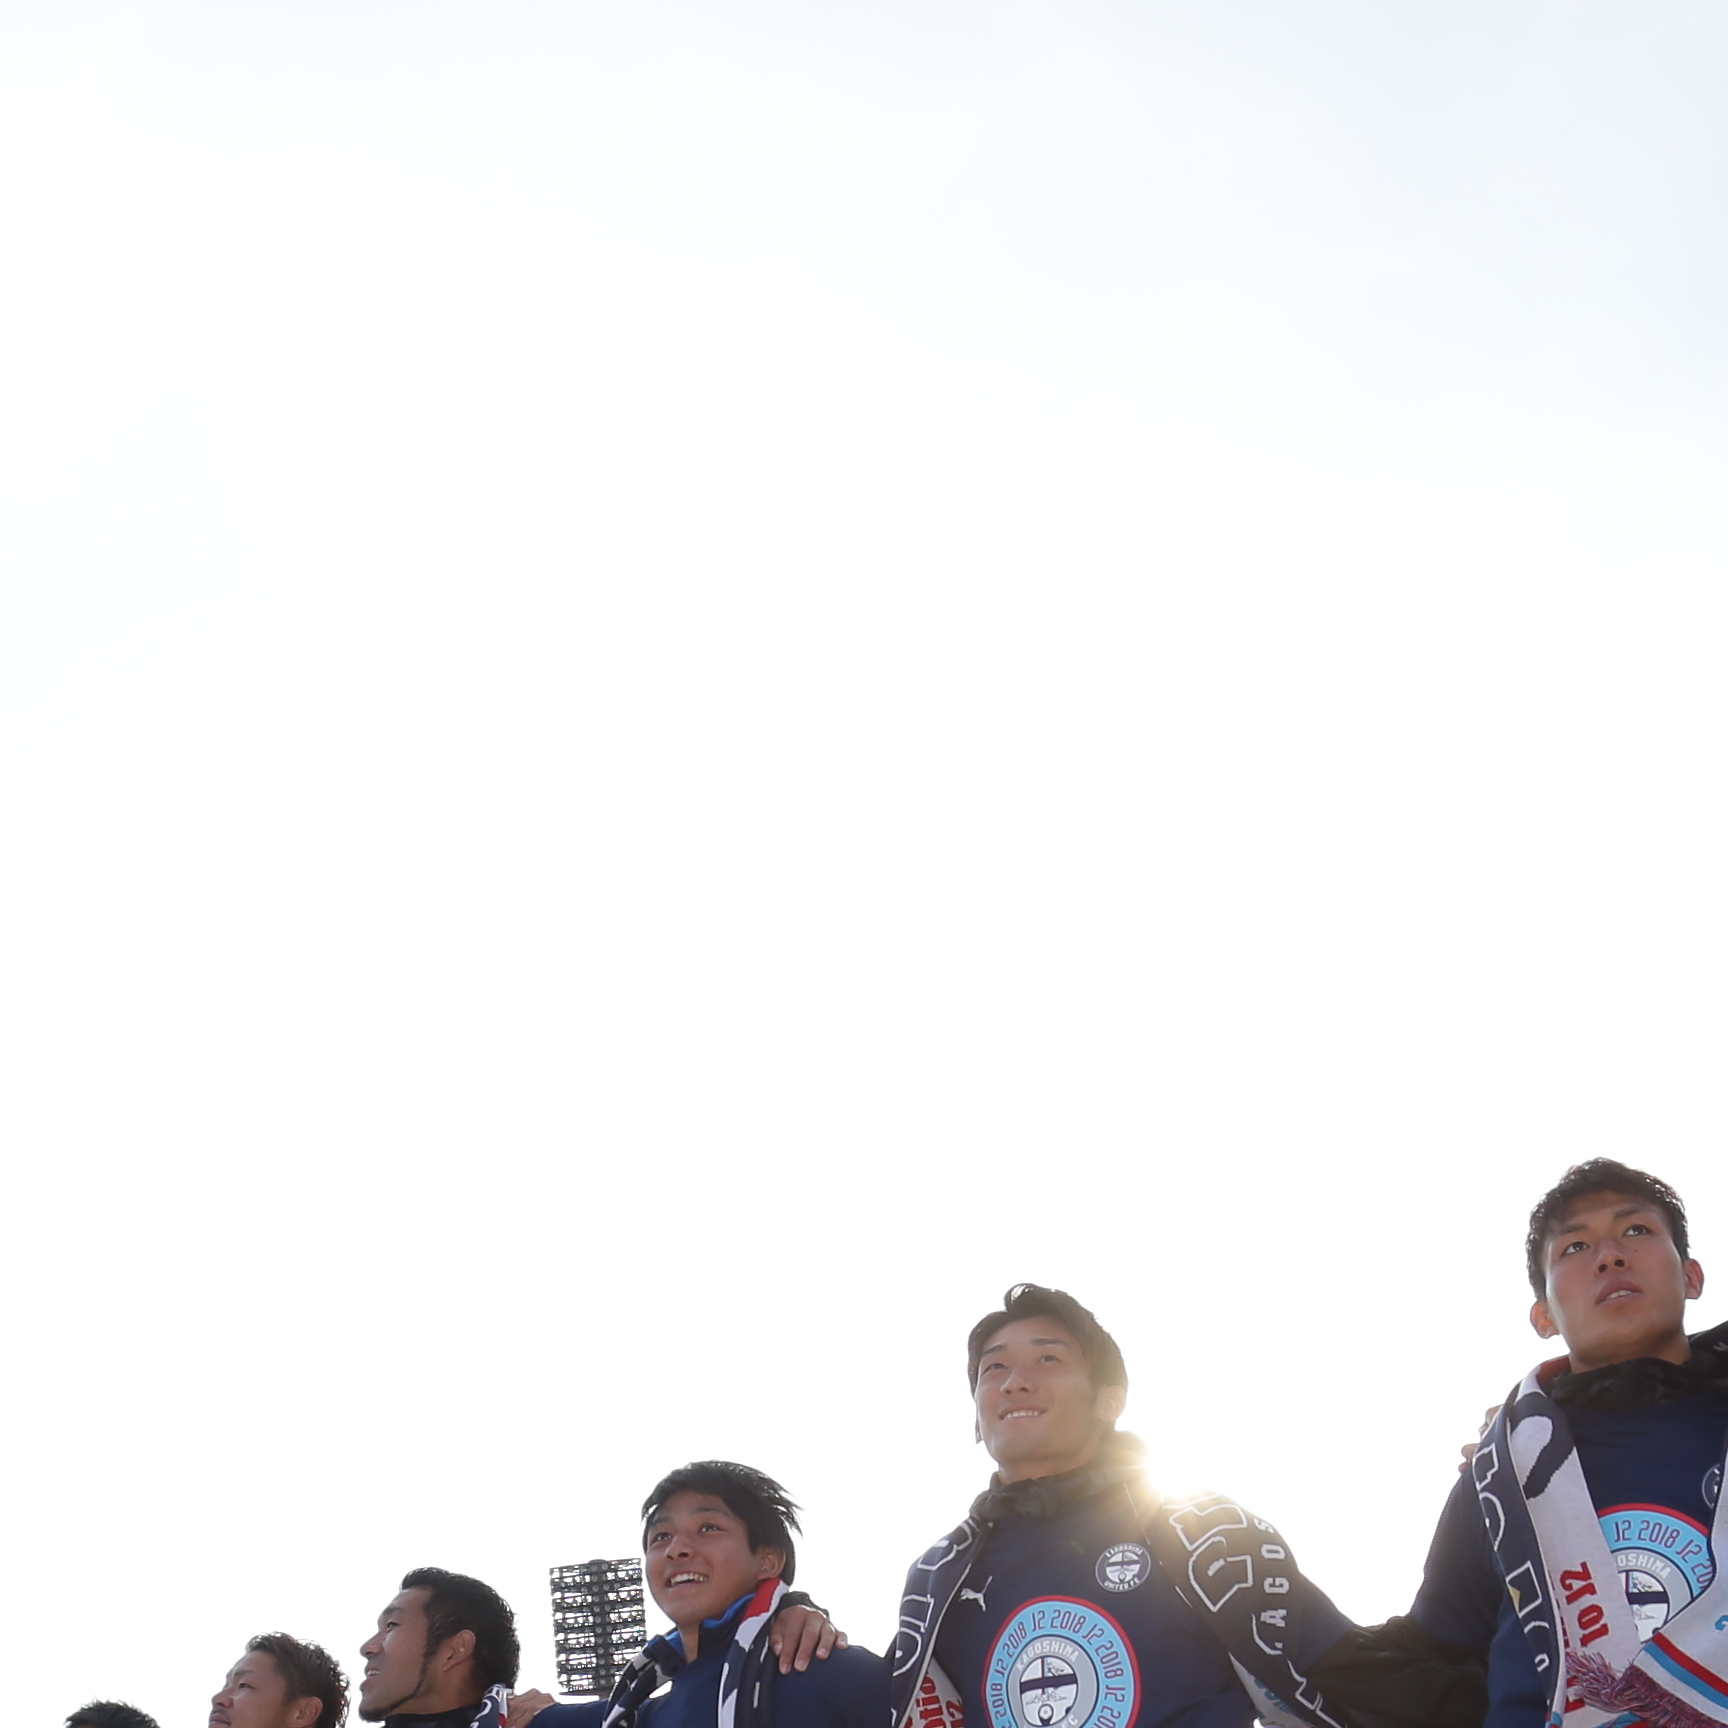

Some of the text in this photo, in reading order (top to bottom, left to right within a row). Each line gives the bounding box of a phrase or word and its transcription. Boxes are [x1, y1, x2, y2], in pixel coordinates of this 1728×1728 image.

[1613, 1519, 1715, 1591] J2 2018 J2 20
[1617, 1554, 1672, 1579] OSHIMA
[1559, 1560, 1598, 1605] J2
[1031, 1610, 1046, 1632] J2
[1050, 1609, 1087, 1634] 2018
[1081, 1623, 1105, 1646] J2
[1577, 1603, 1610, 1648] to
[1002, 1621, 1027, 1659] 2018
[1016, 1640, 1080, 1672] KAGOSHIMA
[995, 1658, 1009, 1678] J2
[1095, 1640, 1125, 1680] 2018
[990, 1682, 1007, 1720] 2018
[1104, 1685, 1126, 1703] J2
